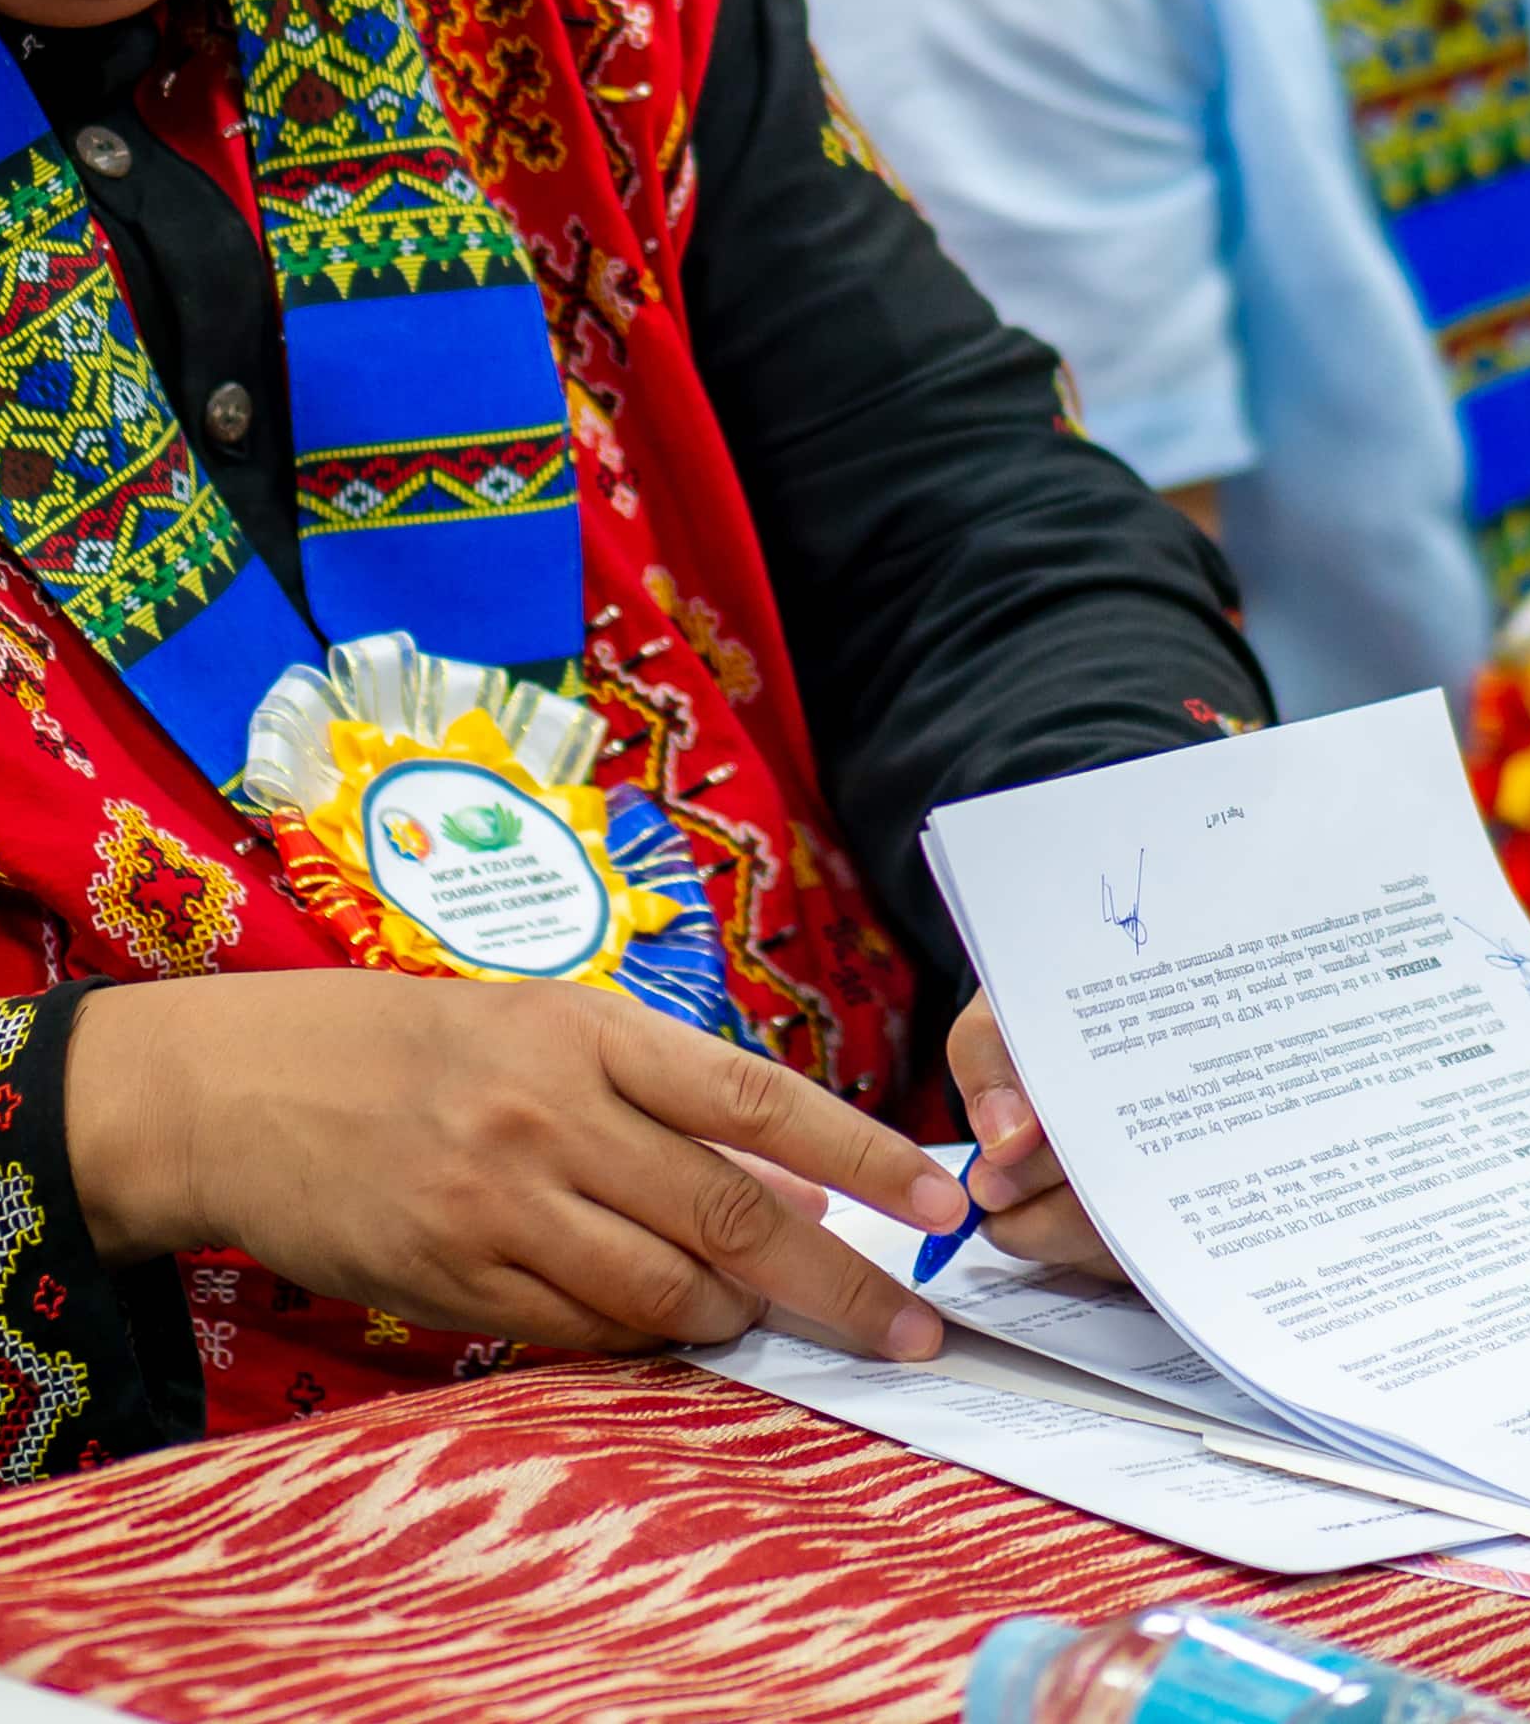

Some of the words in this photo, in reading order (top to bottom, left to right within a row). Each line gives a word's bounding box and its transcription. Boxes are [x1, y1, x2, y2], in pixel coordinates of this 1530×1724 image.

[1227, 806, 1244, 818] Page
[430, 868, 465, 883] NCIP
[482, 860, 510, 874] TZU
[511, 855, 539, 868] CHI
[431, 877, 527, 903] FOUNDATION
[527, 870, 562, 885] MOA
[437, 900, 500, 923] SIGNING
[500, 884, 581, 910] CEREMONY
[1384, 893, 1436, 915] agreements
[1362, 908, 1382, 925] and
[1387, 913, 1445, 936] development
[1292, 915, 1360, 940] arrangements
[1238, 940, 1264, 955] other
[1266, 934, 1289, 949] with
[1176, 944, 1234, 971] government
[1267, 951, 1304, 969] subject
[1130, 962, 1173, 983] agencies
[1215, 964, 1255, 982] existing
[1293, 969, 1314, 986] and
[1083, 979, 1114, 997] attain
[1150, 985, 1176, 1000] enter
[1248, 973, 1287, 995] projects
[1297, 984, 1340, 1002] function
[1341, 978, 1359, 992] the
[1066, 988, 1081, 1000] its
[1126, 992, 1148, 1006] into
[1202, 995, 1220, 1009] the
[1227, 989, 1242, 1003] for
[1148, 1001, 1195, 1021] economic
[1238, 1005, 1264, 1022] NCIP
[1265, 999, 1283, 1013] the
[1119, 1016, 1140, 1033] and
[1172, 1016, 1221, 1037] formulate
[1081, 1024, 1112, 1044] social
[1147, 1030, 1168, 1047] and
[1091, 1036, 1146, 1060] implement
[1254, 1044, 1274, 1060] and
[1343, 1053, 1380, 1074] protect
[1223, 1069, 1264, 1087] Peoples
[1277, 1070, 1320, 1092] promote
[1320, 1066, 1342, 1083] and
[1216, 1091, 1257, 1111] interest
[1258, 1085, 1277, 1099] the
[1303, 1079, 1363, 1106] government
[1117, 1103, 1138, 1117] due
[1140, 1097, 1165, 1113] with
[1193, 1103, 1215, 1120] and
[1266, 1098, 1301, 1116] agency
[1137, 1111, 1192, 1132] well-being
[1224, 1110, 1263, 1132] created
[1175, 1128, 1207, 1143] virtue
[1311, 1140, 1360, 1164] programs
[1264, 1159, 1307, 1178] services
[1310, 1168, 1345, 1187] Social
[1389, 1156, 1445, 1181] recognized
[1245, 1173, 1263, 1186] for
[1365, 1173, 1388, 1189] and
[1195, 1180, 1240, 1199] children
[1273, 1182, 1306, 1197] Work
[1310, 1181, 1365, 1206] accredited
[1378, 1174, 1452, 1204] COMPASSION
[1169, 1194, 1192, 1211] and
[1228, 1191, 1267, 1210] Agency
[1336, 1198, 1377, 1219] RELIEF
[1181, 1212, 1202, 1225] the
[1273, 1204, 1294, 1216] the
[1208, 1211, 1274, 1236] Department
[1284, 1220, 1309, 1235] CHI
[1309, 1212, 1336, 1227] TZU
[1208, 1228, 1285, 1259] FOUNDATION
